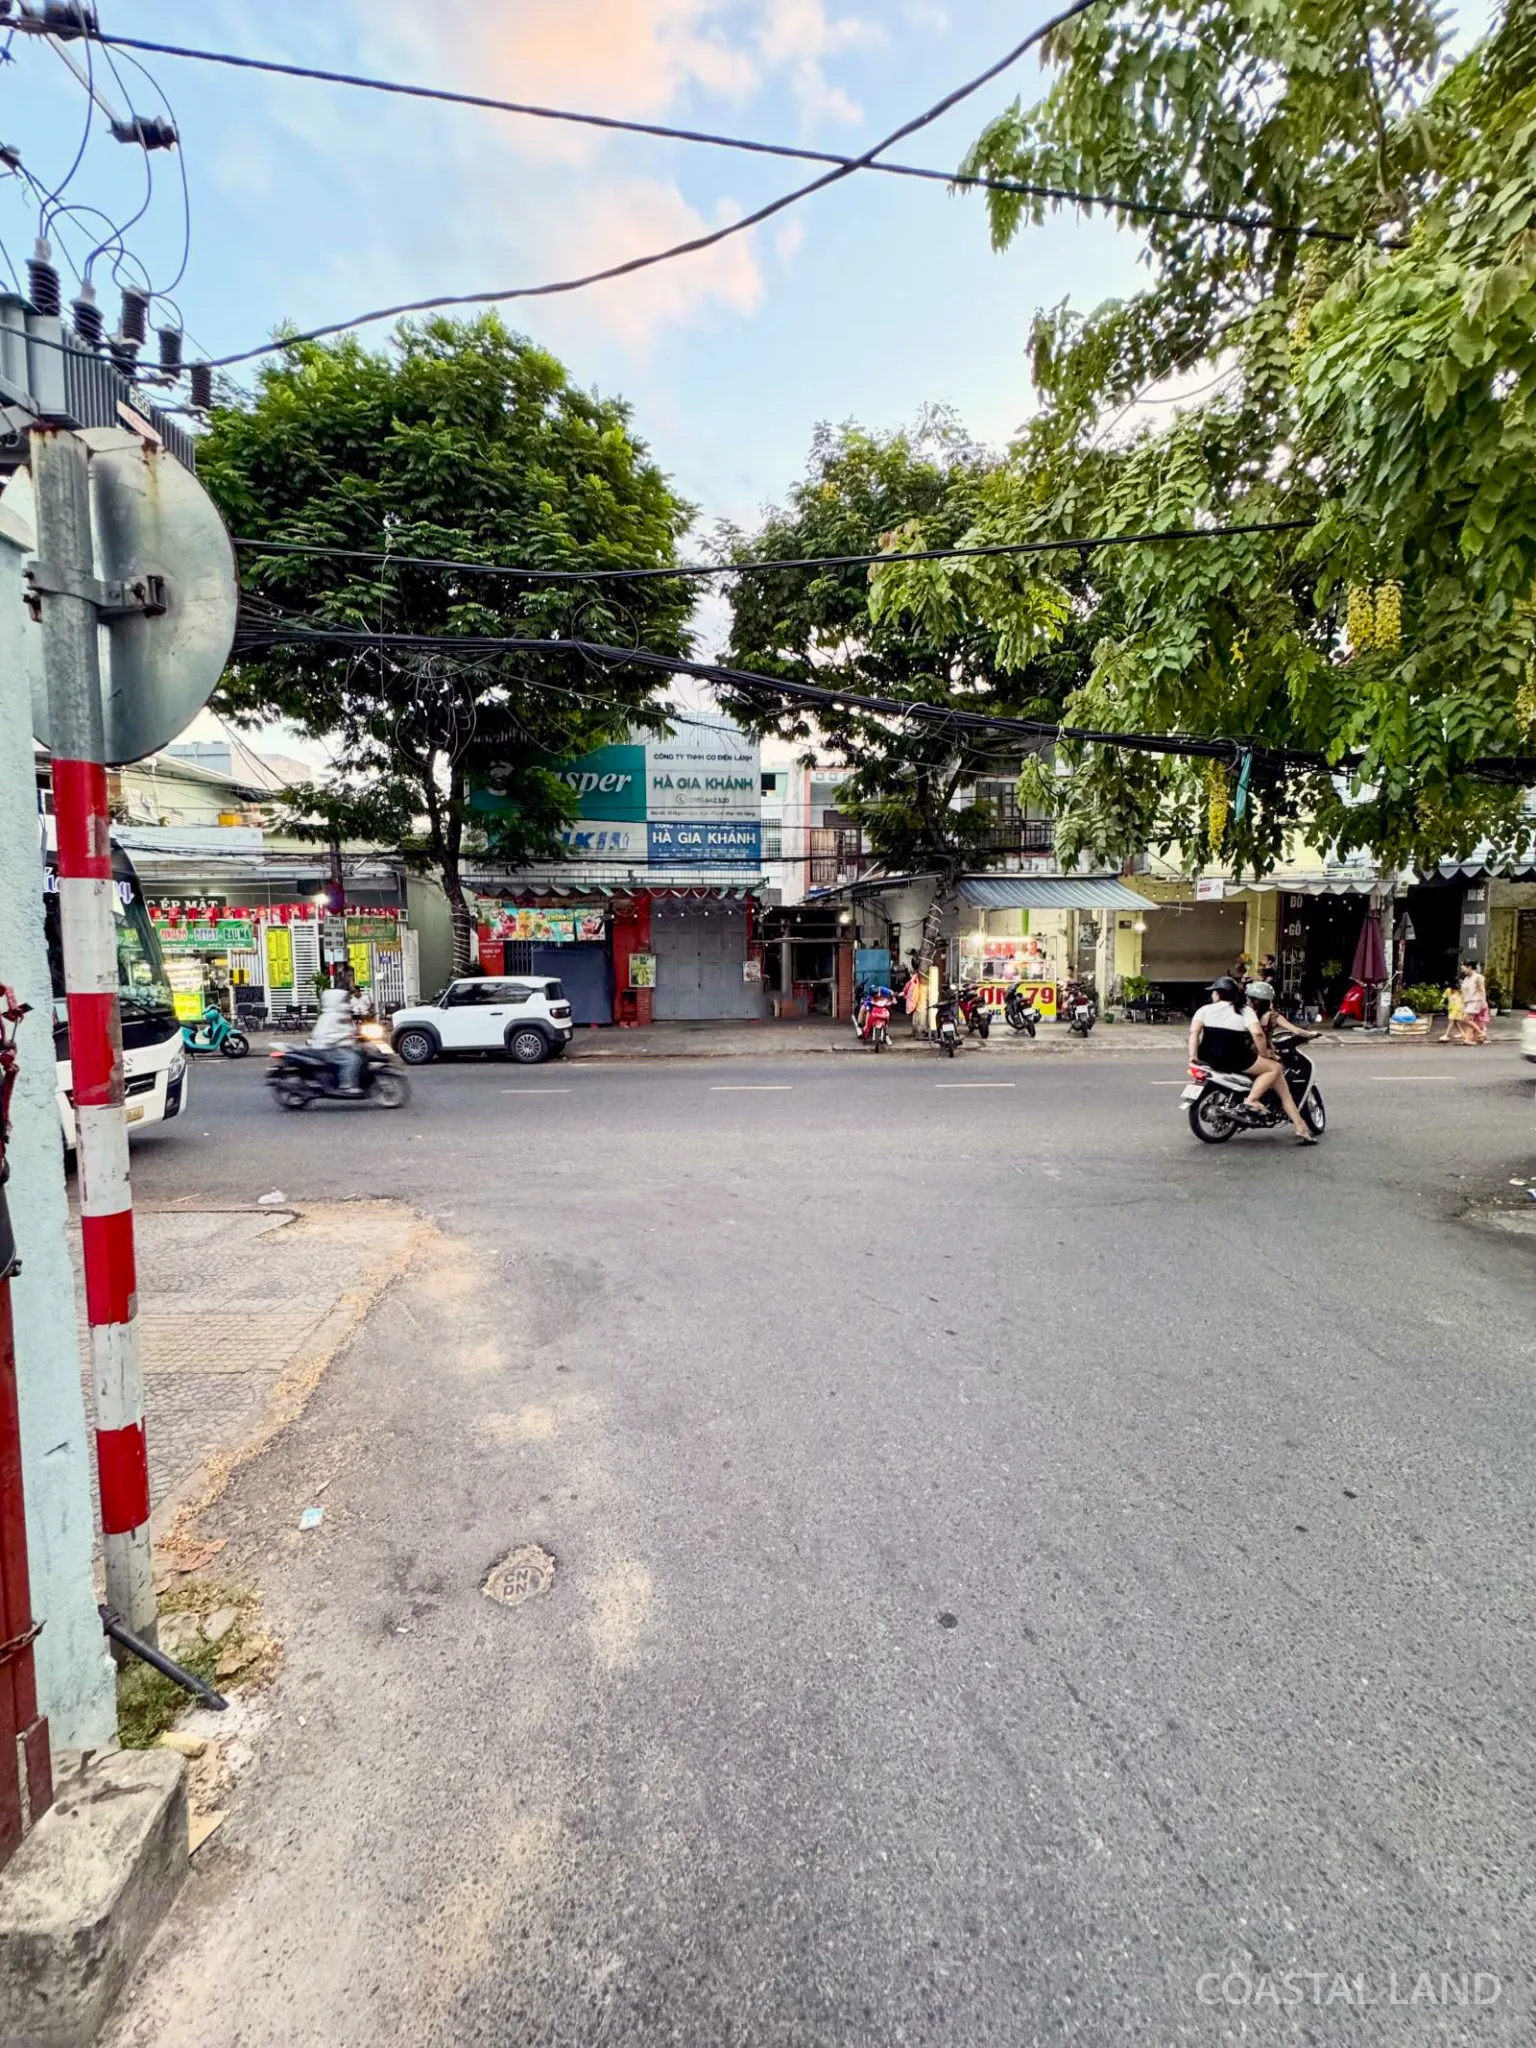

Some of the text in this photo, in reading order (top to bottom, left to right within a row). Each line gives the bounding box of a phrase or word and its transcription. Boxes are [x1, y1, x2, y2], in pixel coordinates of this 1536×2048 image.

[131, 391, 149, 415] 250
[653, 774, 753, 791] HÀ GIA KHÁNH
[652, 829, 756, 844] HÀ GIA KHÁNH
[1025, 987, 1054, 1005] 79
[504, 1569, 529, 1584] CN
